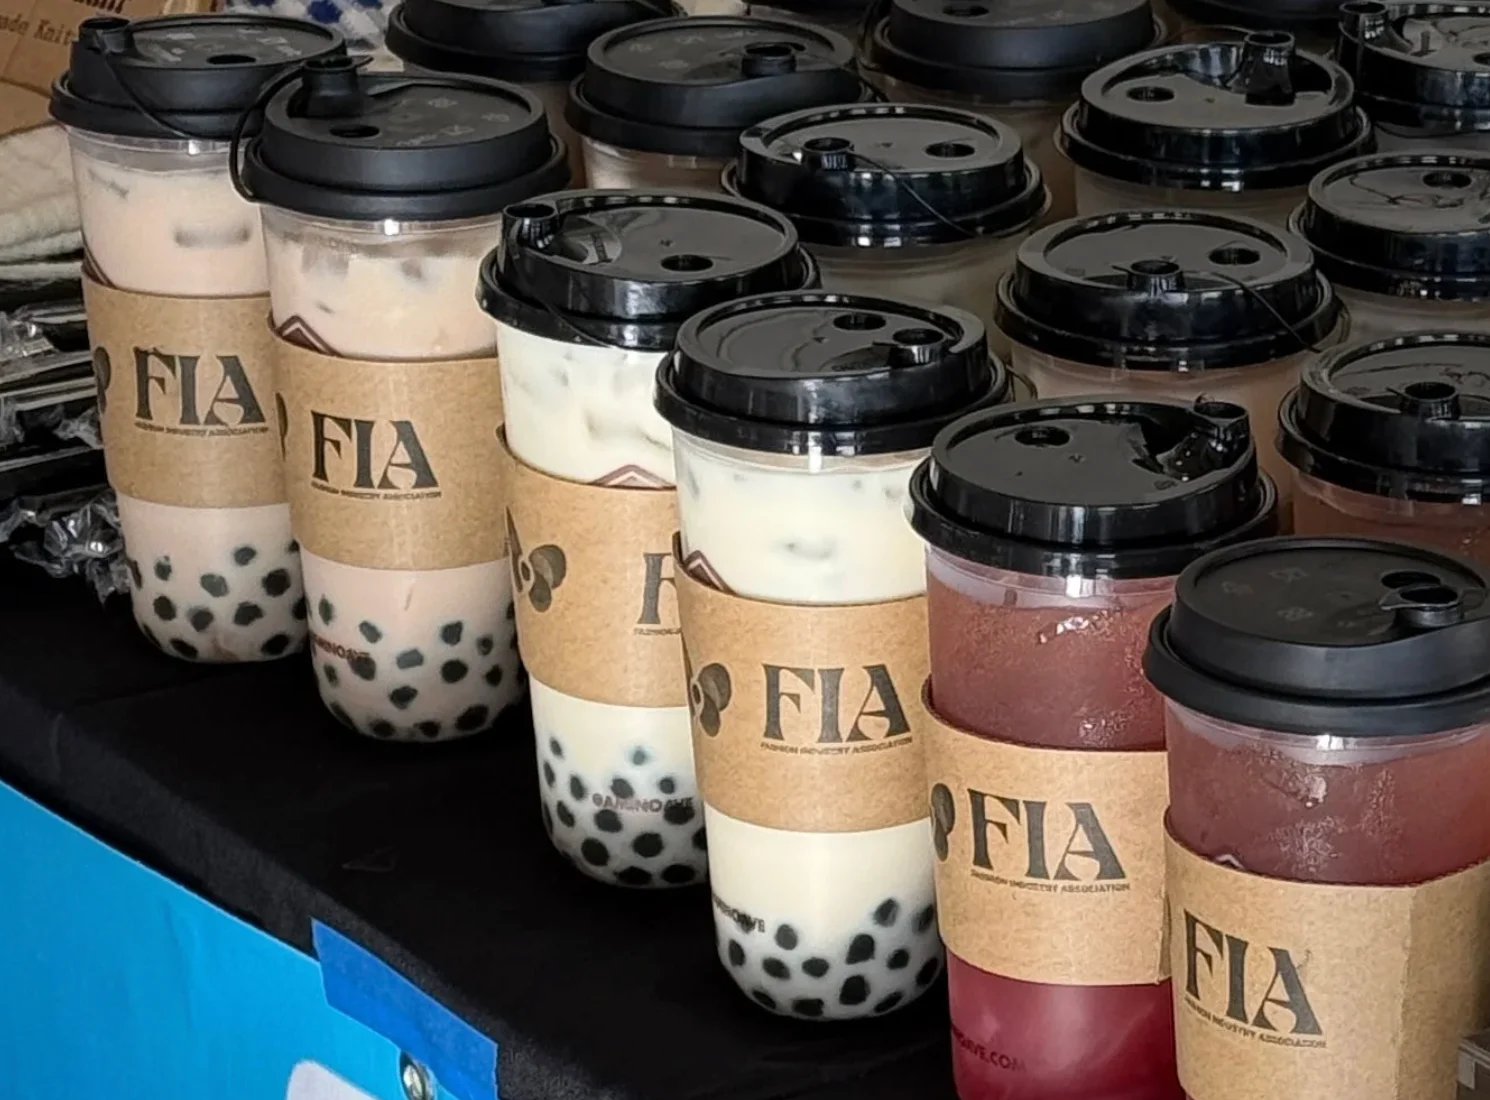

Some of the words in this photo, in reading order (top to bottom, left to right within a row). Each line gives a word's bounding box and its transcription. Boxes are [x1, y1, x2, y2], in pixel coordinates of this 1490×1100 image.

[133, 346, 266, 425] FIA
[310, 409, 440, 489] FIA
[762, 663, 911, 743] FIA
[967, 788, 1126, 880] FIA
[1060, 882, 1131, 894] ASSOCIATION
[1184, 908, 1323, 1036] FIA
